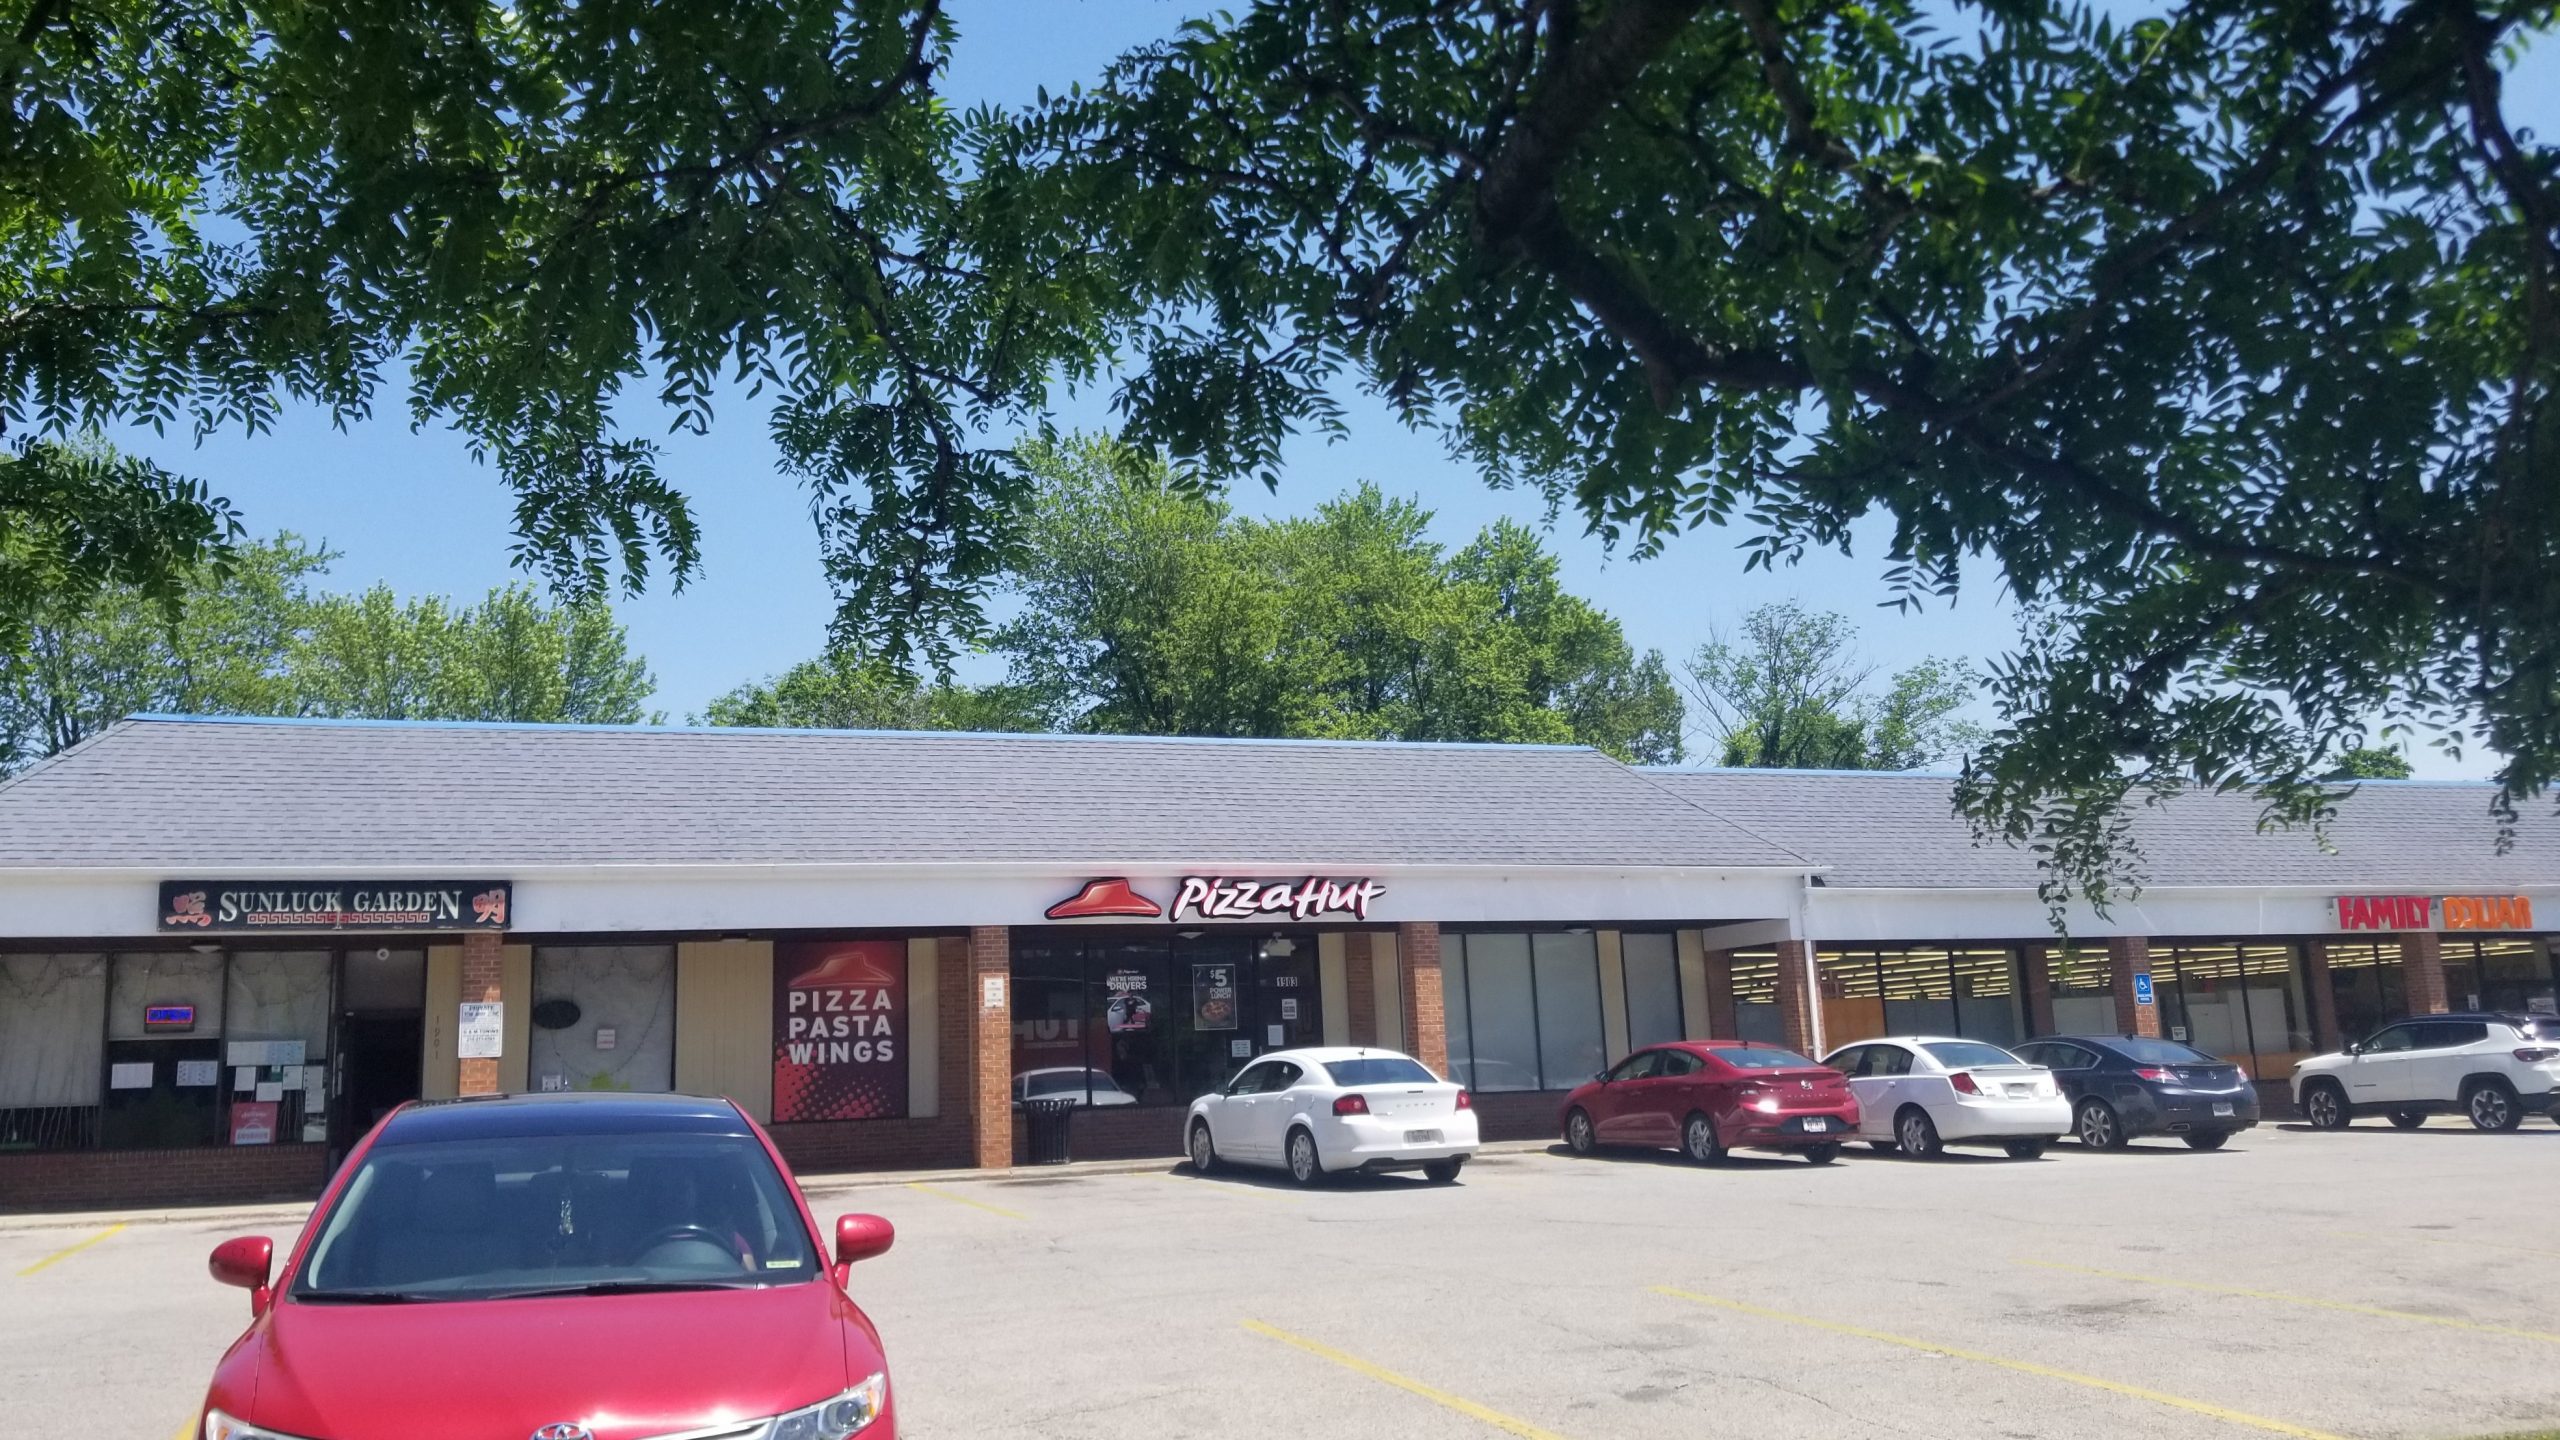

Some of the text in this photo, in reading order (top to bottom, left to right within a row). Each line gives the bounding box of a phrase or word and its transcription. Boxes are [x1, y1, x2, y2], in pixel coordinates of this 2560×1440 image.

[218, 889, 463, 923] SUNLUCK GARDEN
[2338, 895, 2533, 930] FAMILY DOLLAR
[1109, 981, 1147, 991] DRIVERS
[789, 989, 892, 1013] PIZZA
[789, 1014, 892, 1039] PASTA
[788, 1040, 894, 1065] WINGS
